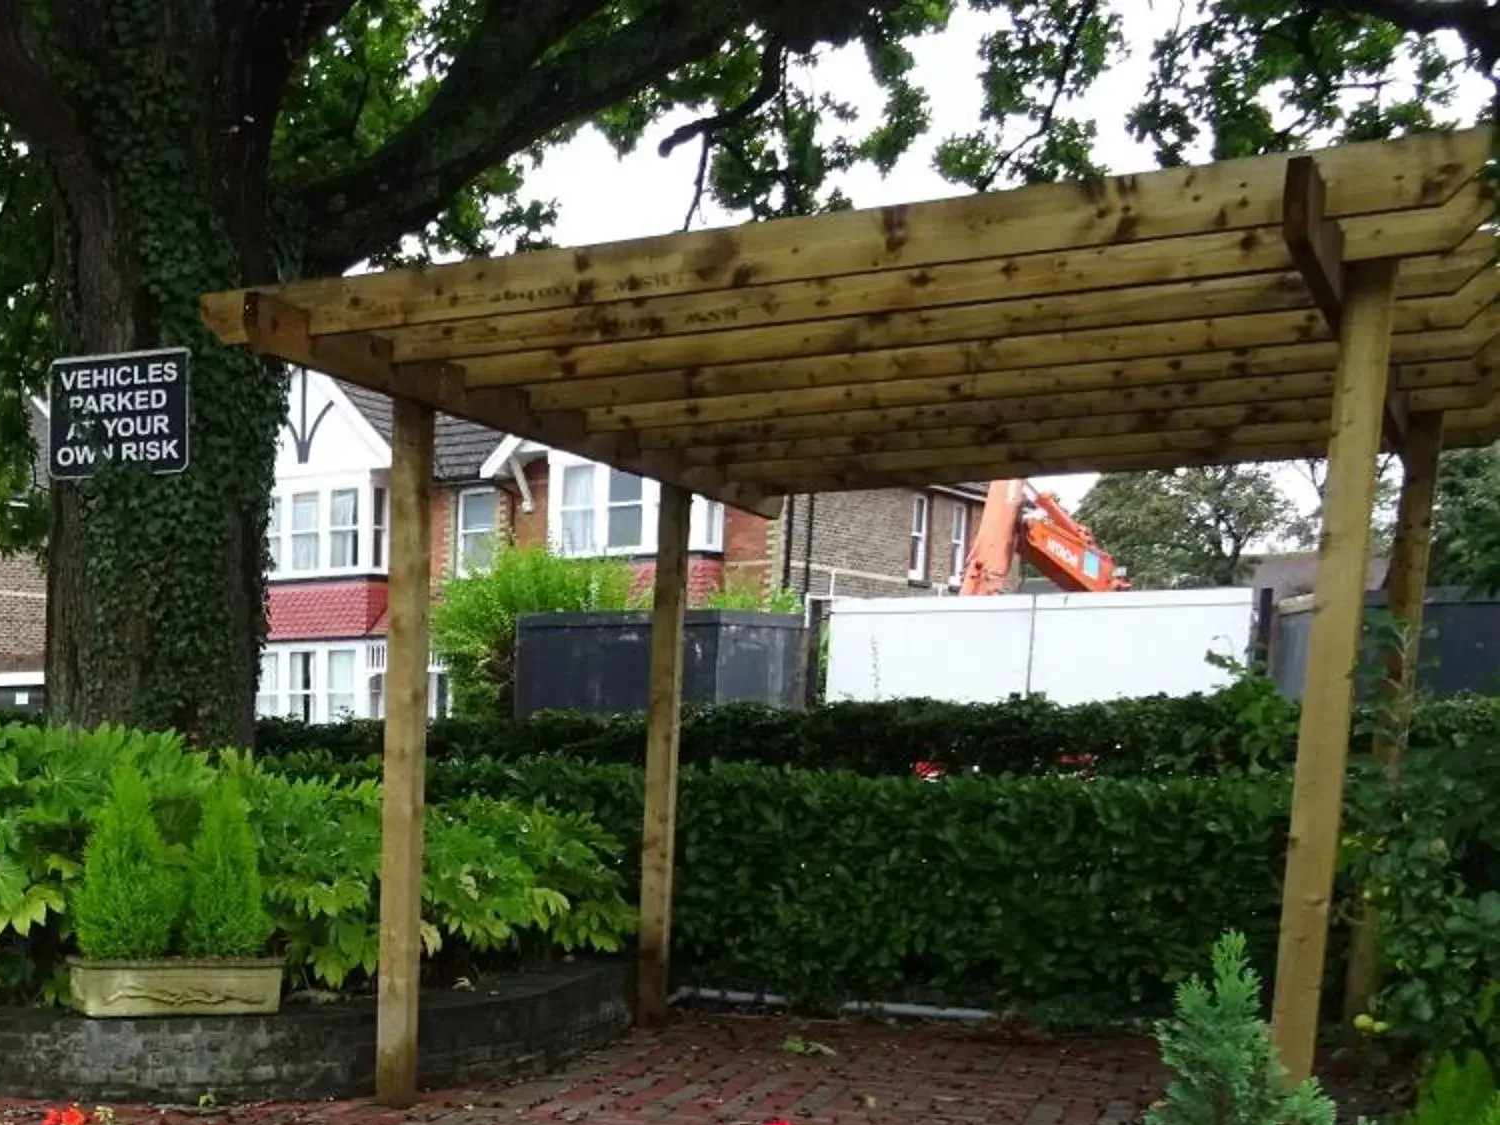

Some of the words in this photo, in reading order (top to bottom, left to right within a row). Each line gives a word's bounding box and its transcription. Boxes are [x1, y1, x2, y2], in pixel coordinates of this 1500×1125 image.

[60, 362, 177, 391] VEHICLES
[69, 389, 167, 414] PARKED
[102, 415, 169, 439] YOUR
[121, 439, 179, 461] RISK
